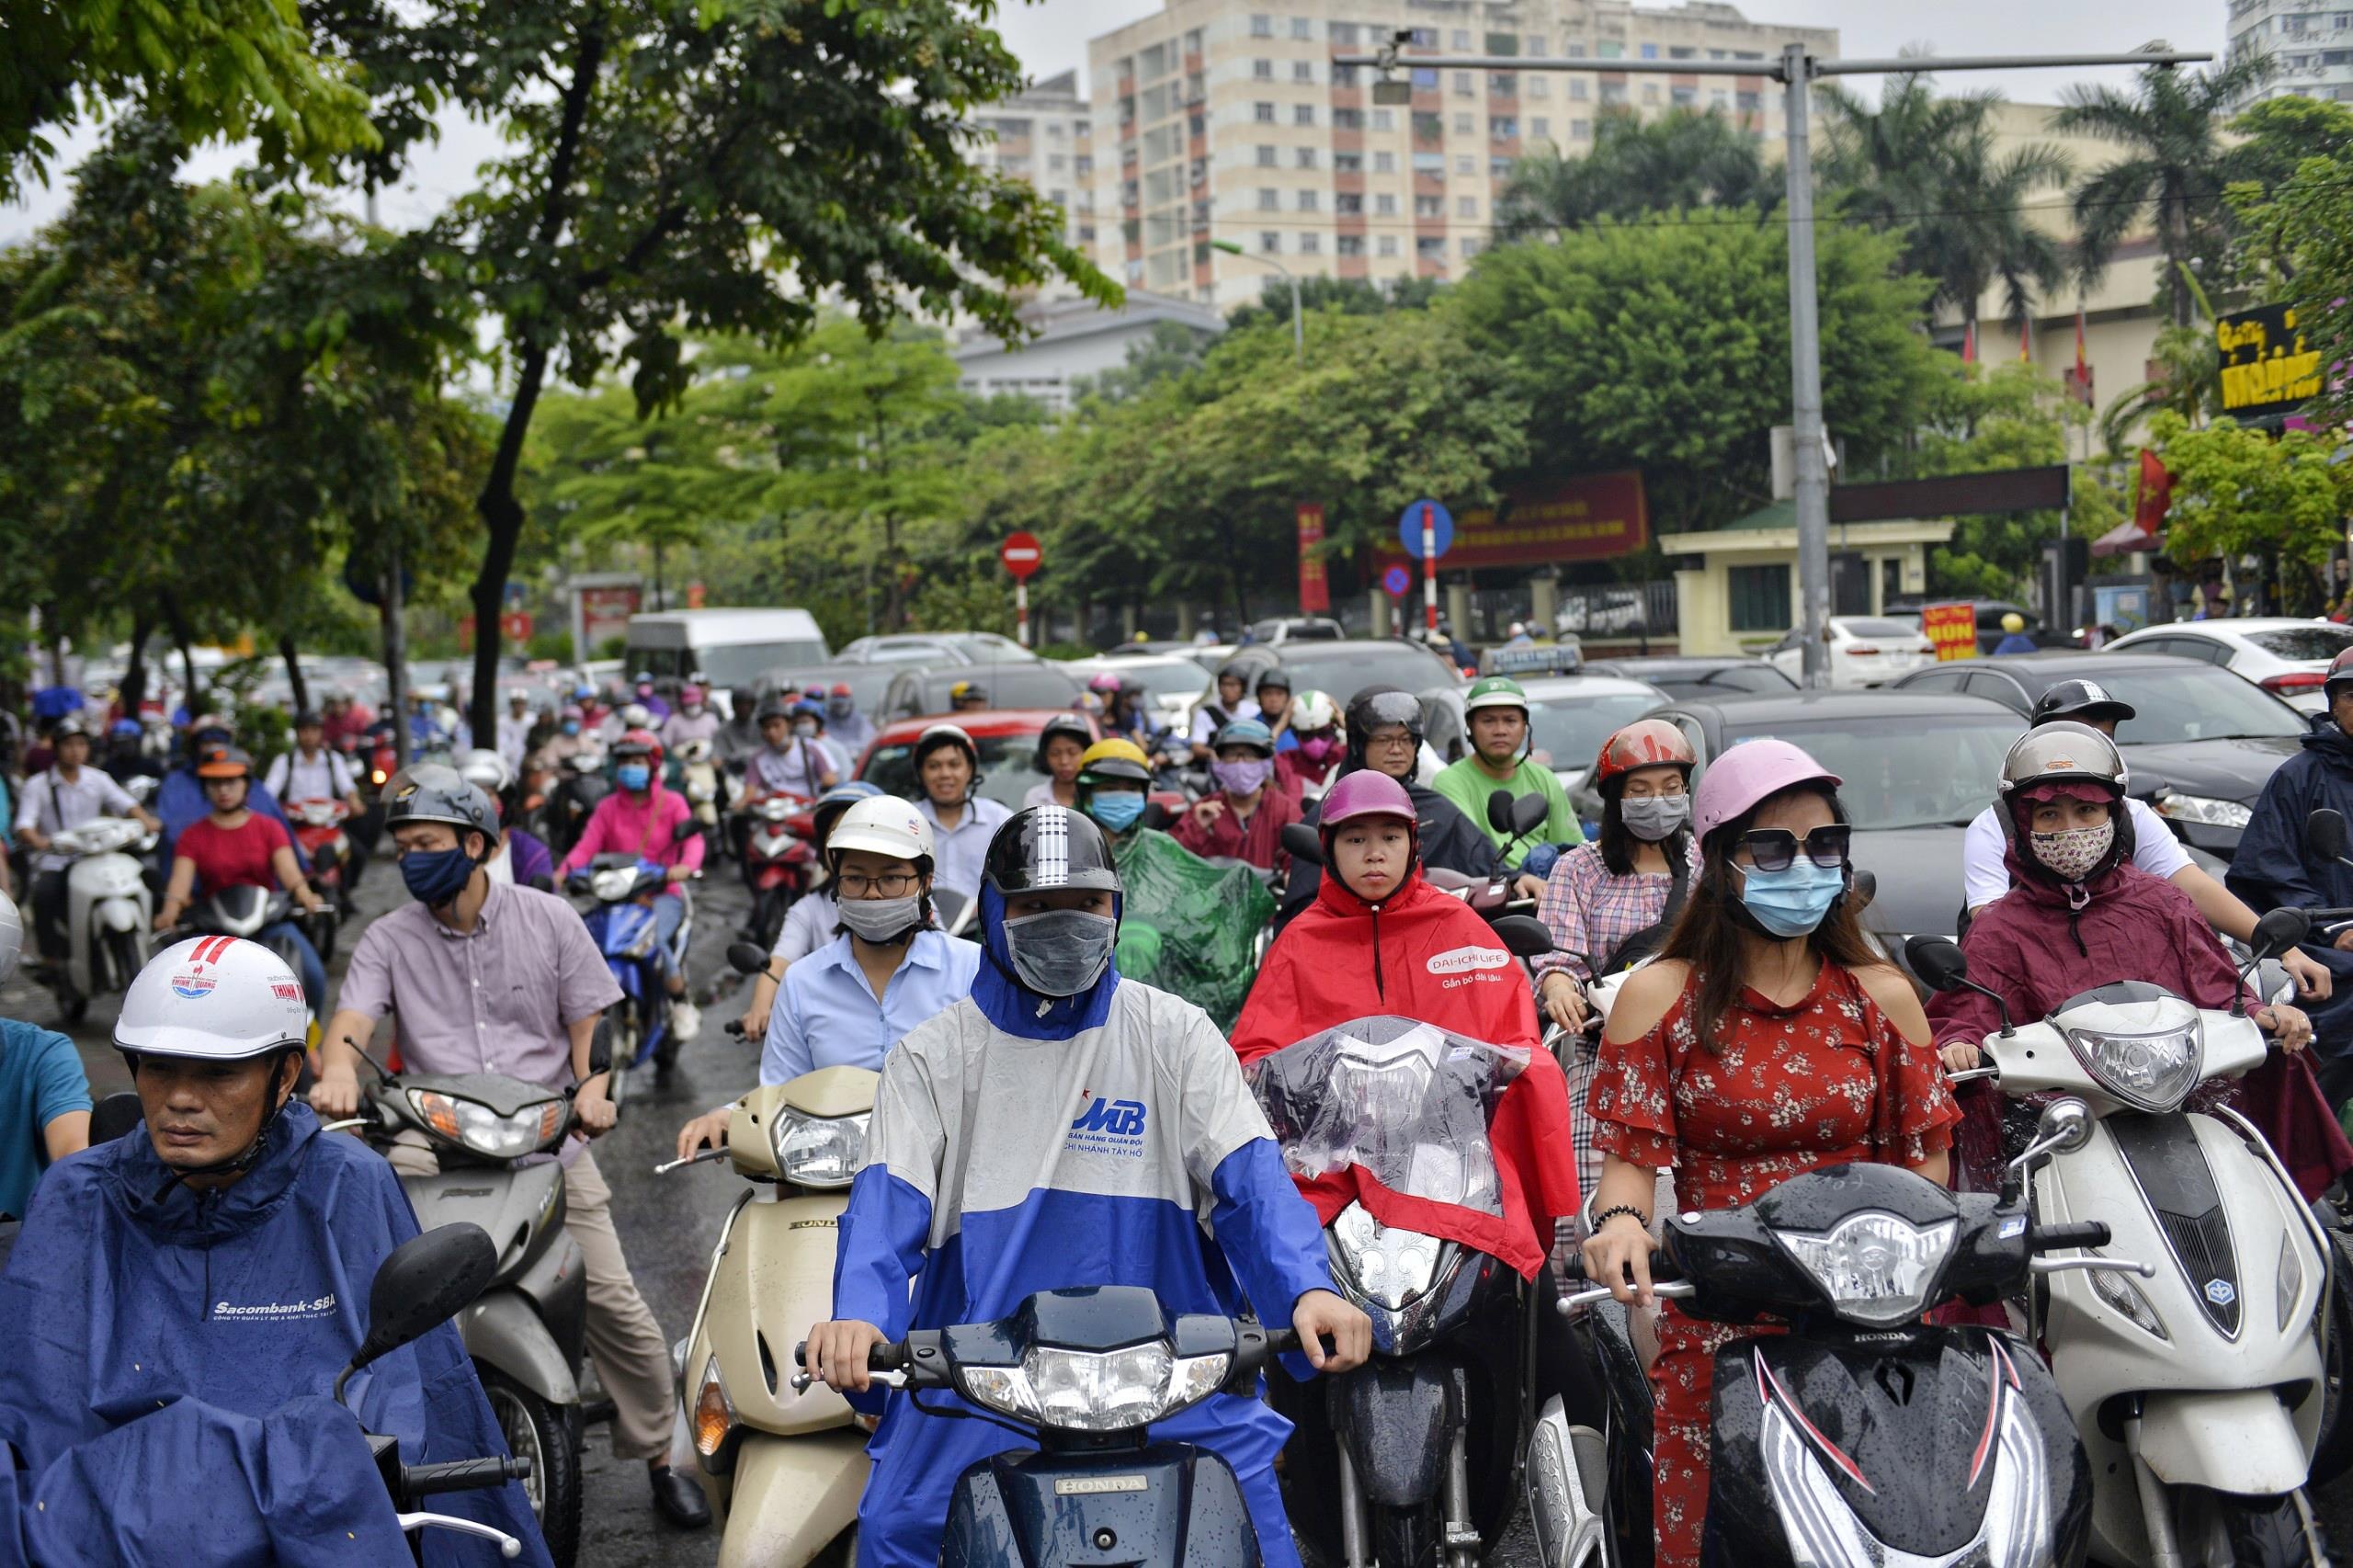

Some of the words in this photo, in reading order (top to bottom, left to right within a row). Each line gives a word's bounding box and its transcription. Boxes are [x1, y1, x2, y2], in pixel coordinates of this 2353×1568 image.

[1433, 953, 1479, 970] DAI-ICHI
[1480, 954, 1504, 963] LIFE
[1072, 1097, 1147, 1135] MB
[1067, 1131, 1084, 1141] GÂN
[789, 1219, 838, 1230] HOND
[214, 1293, 335, 1314] Sacombank-SBA
[1855, 1332, 1912, 1343] HONDA
[1060, 1477, 1143, 1493] HONDA
